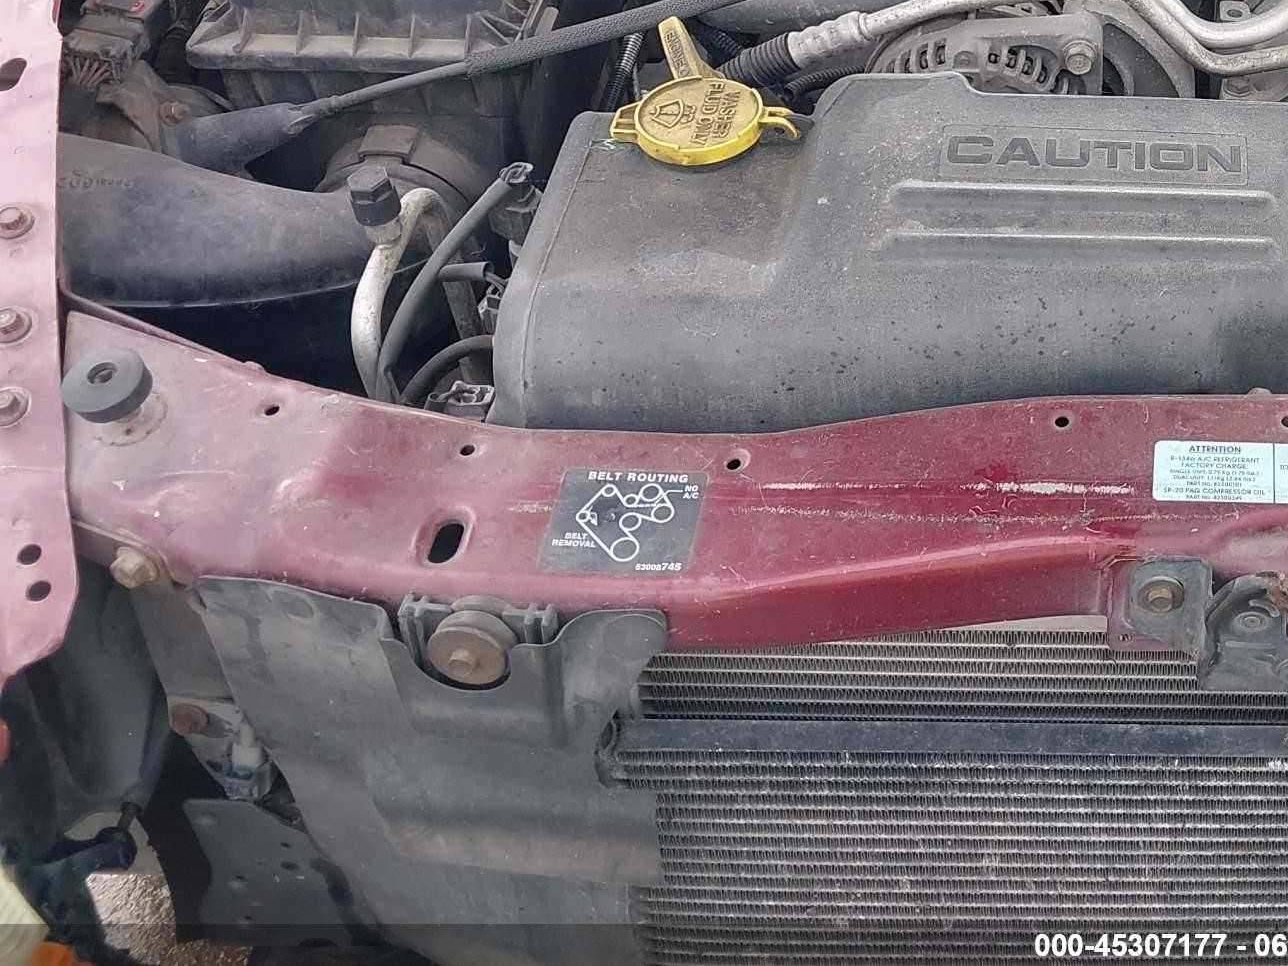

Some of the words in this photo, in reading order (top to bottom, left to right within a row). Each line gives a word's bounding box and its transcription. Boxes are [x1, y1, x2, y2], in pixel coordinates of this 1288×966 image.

[666, 31, 687, 70] ENGINE
[713, 89, 741, 139] WASHER
[690, 116, 713, 146] ONLY
[946, 134, 1243, 173] CAUTION
[1188, 445, 1241, 454] ATTENTION
[1213, 456, 1260, 464] REFRIGERANT
[588, 470, 623, 482] BELT
[627, 472, 689, 483] ROUTING
[684, 485, 699, 493] NO
[1163, 486, 1184, 494] SP-20
[1202, 487, 1252, 496] COMPRESSOR
[1253, 489, 1265, 497] OIL
[683, 491, 699, 499] A/C
[564, 532, 588, 541] BELT
[551, 539, 596, 548] REMOVAL
